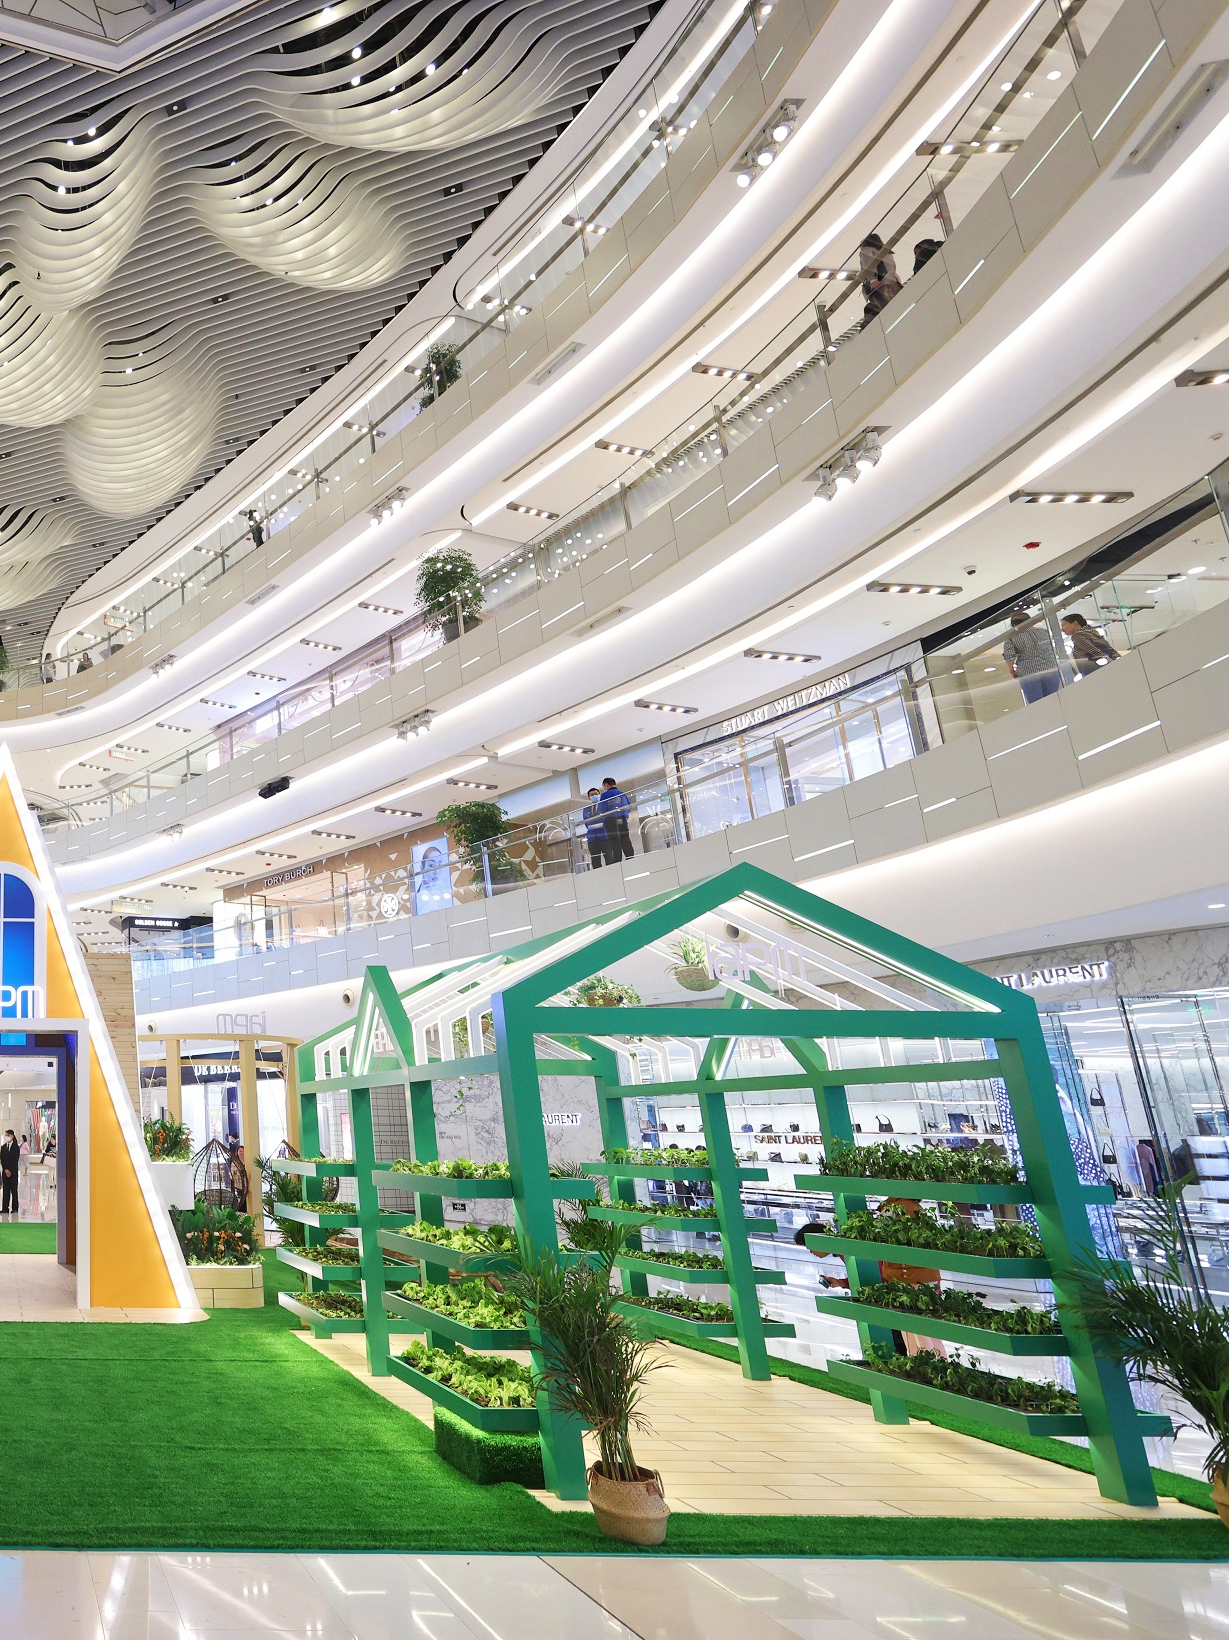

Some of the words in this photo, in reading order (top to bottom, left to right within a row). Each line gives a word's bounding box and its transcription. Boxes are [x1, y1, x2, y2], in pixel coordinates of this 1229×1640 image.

[722, 706, 769, 735] STUART
[773, 673, 851, 715] WEITZMAN
[263, 875, 283, 887] TORY
[285, 866, 314, 880] BURCH
[1017, 961, 1108, 989] LAURENT
[210, 1065, 241, 1075] BEER
[541, 1113, 581, 1125] AURENT
[754, 1134, 783, 1145] SAINT
[785, 1134, 823, 1145] LAURE
